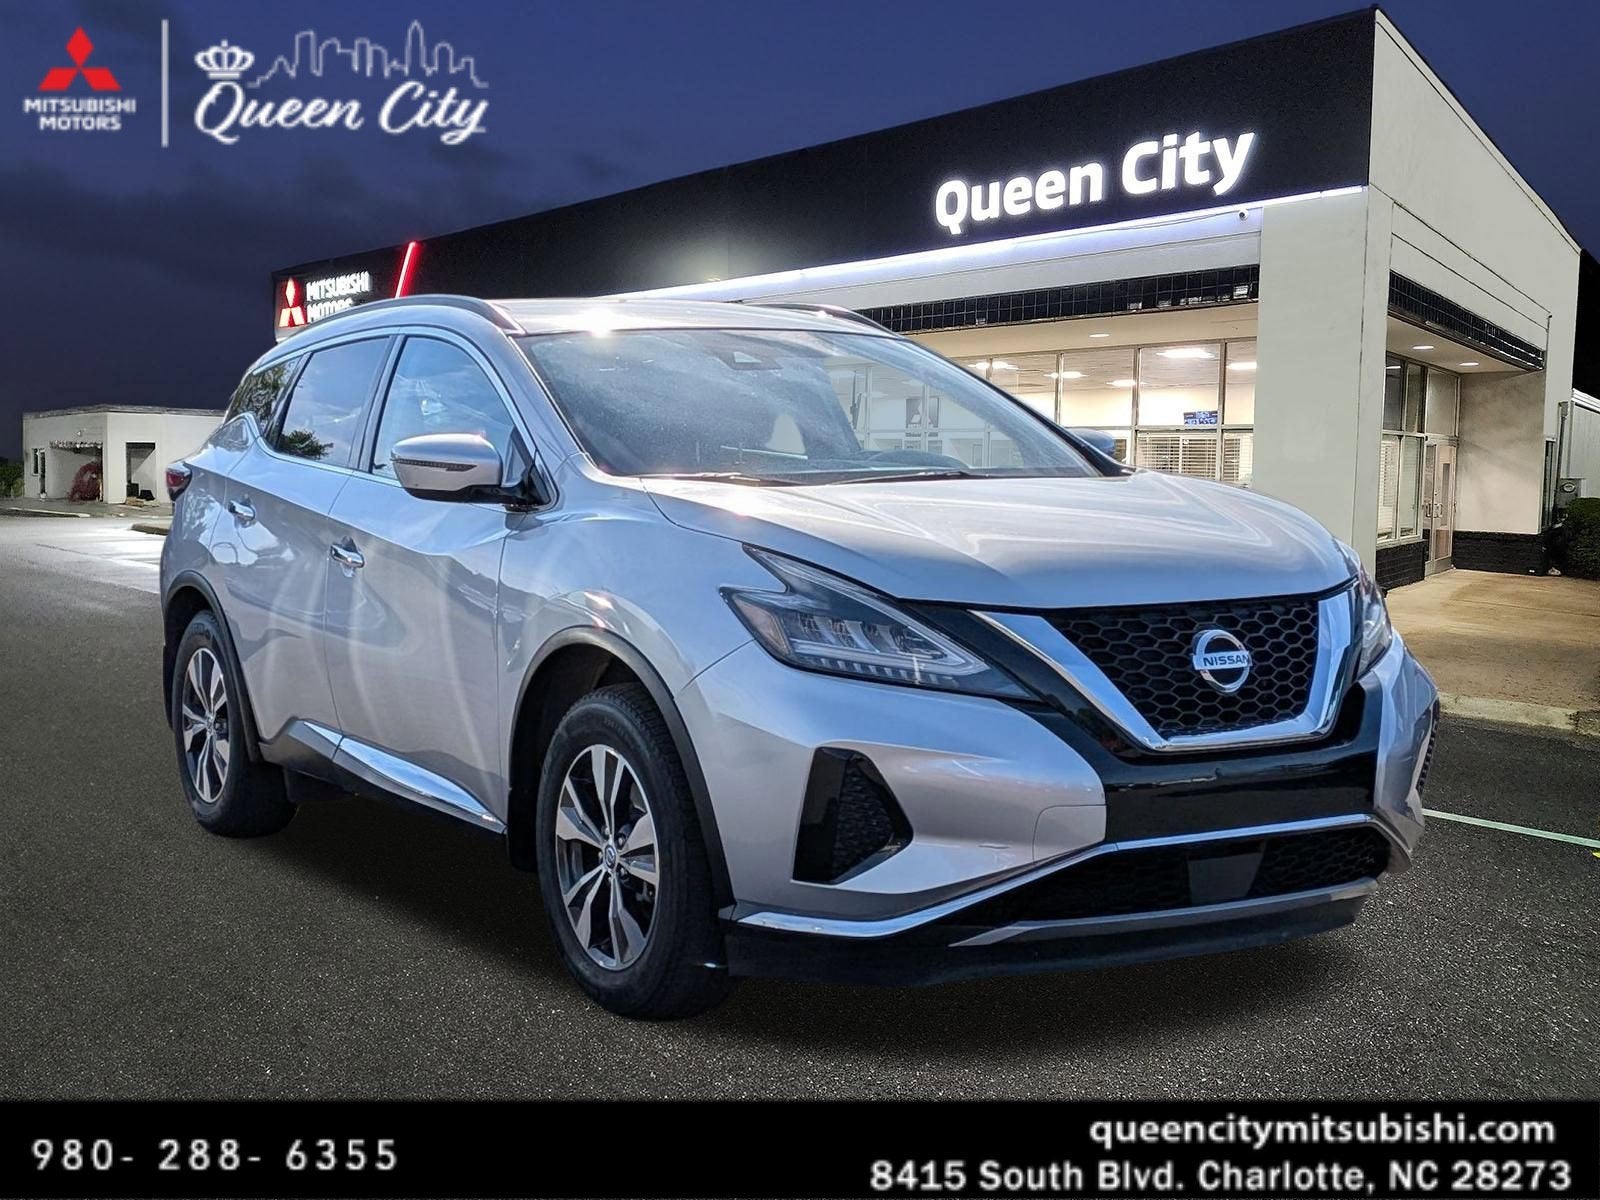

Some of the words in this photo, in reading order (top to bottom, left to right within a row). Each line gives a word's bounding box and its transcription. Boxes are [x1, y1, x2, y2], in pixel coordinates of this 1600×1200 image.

[935, 161, 1105, 235] Queen
[1121, 131, 1255, 196] City
[306, 271, 371, 302] MITSUBISHI
[1203, 654, 1249, 667] NISSAN
